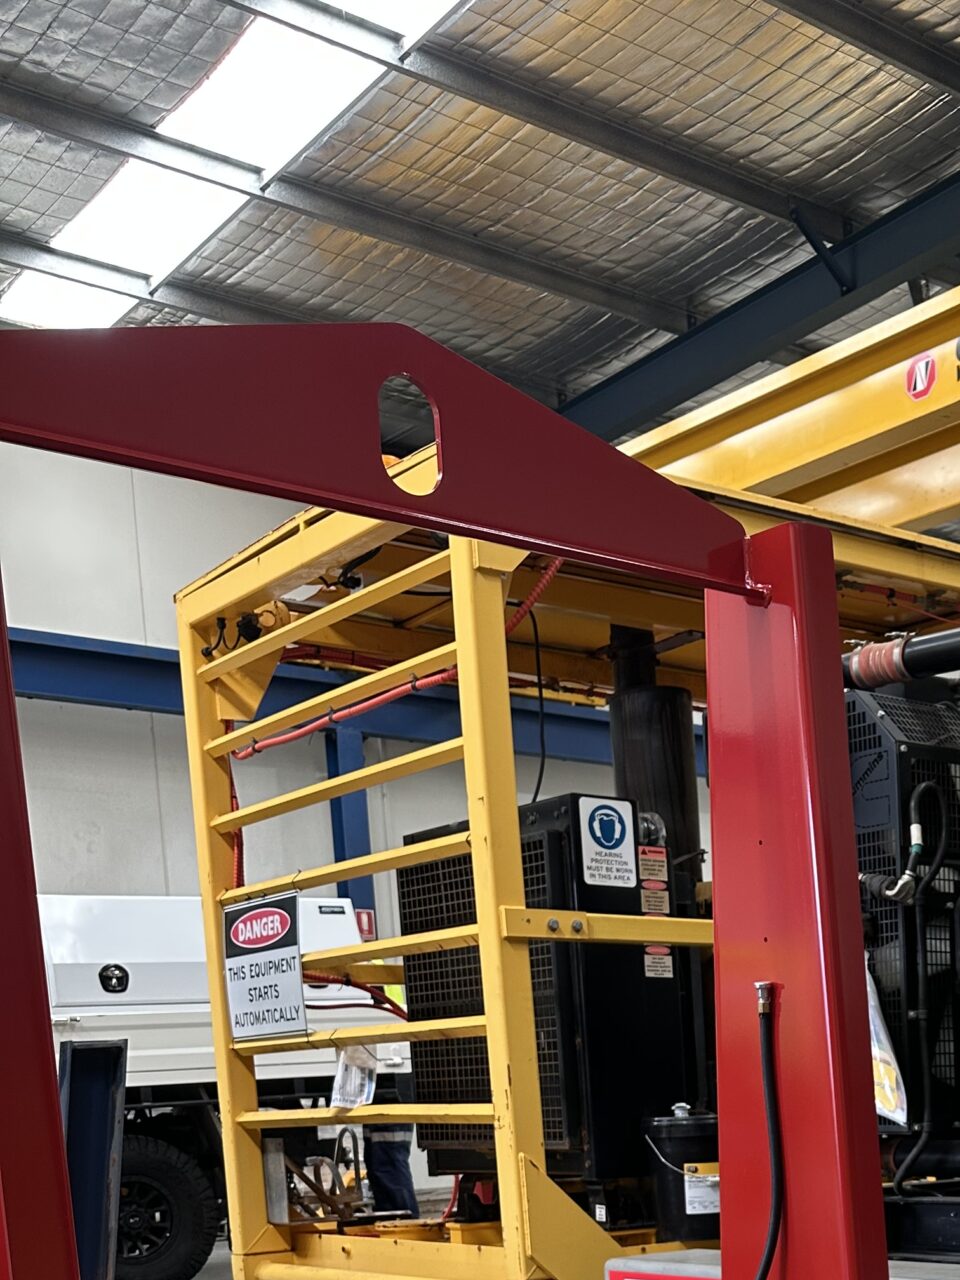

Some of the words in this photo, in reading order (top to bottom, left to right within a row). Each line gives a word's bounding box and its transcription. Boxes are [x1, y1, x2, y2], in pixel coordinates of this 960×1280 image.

[590, 857, 629, 866] PROTECTION
[595, 851, 623, 859] HEARING
[237, 914, 282, 942] DANGER
[228, 964, 246, 982] THIS
[249, 956, 297, 980] EQUIPMENT
[248, 984, 280, 1003] STARTS
[234, 1005, 300, 1028] AUTOMATICALLY
